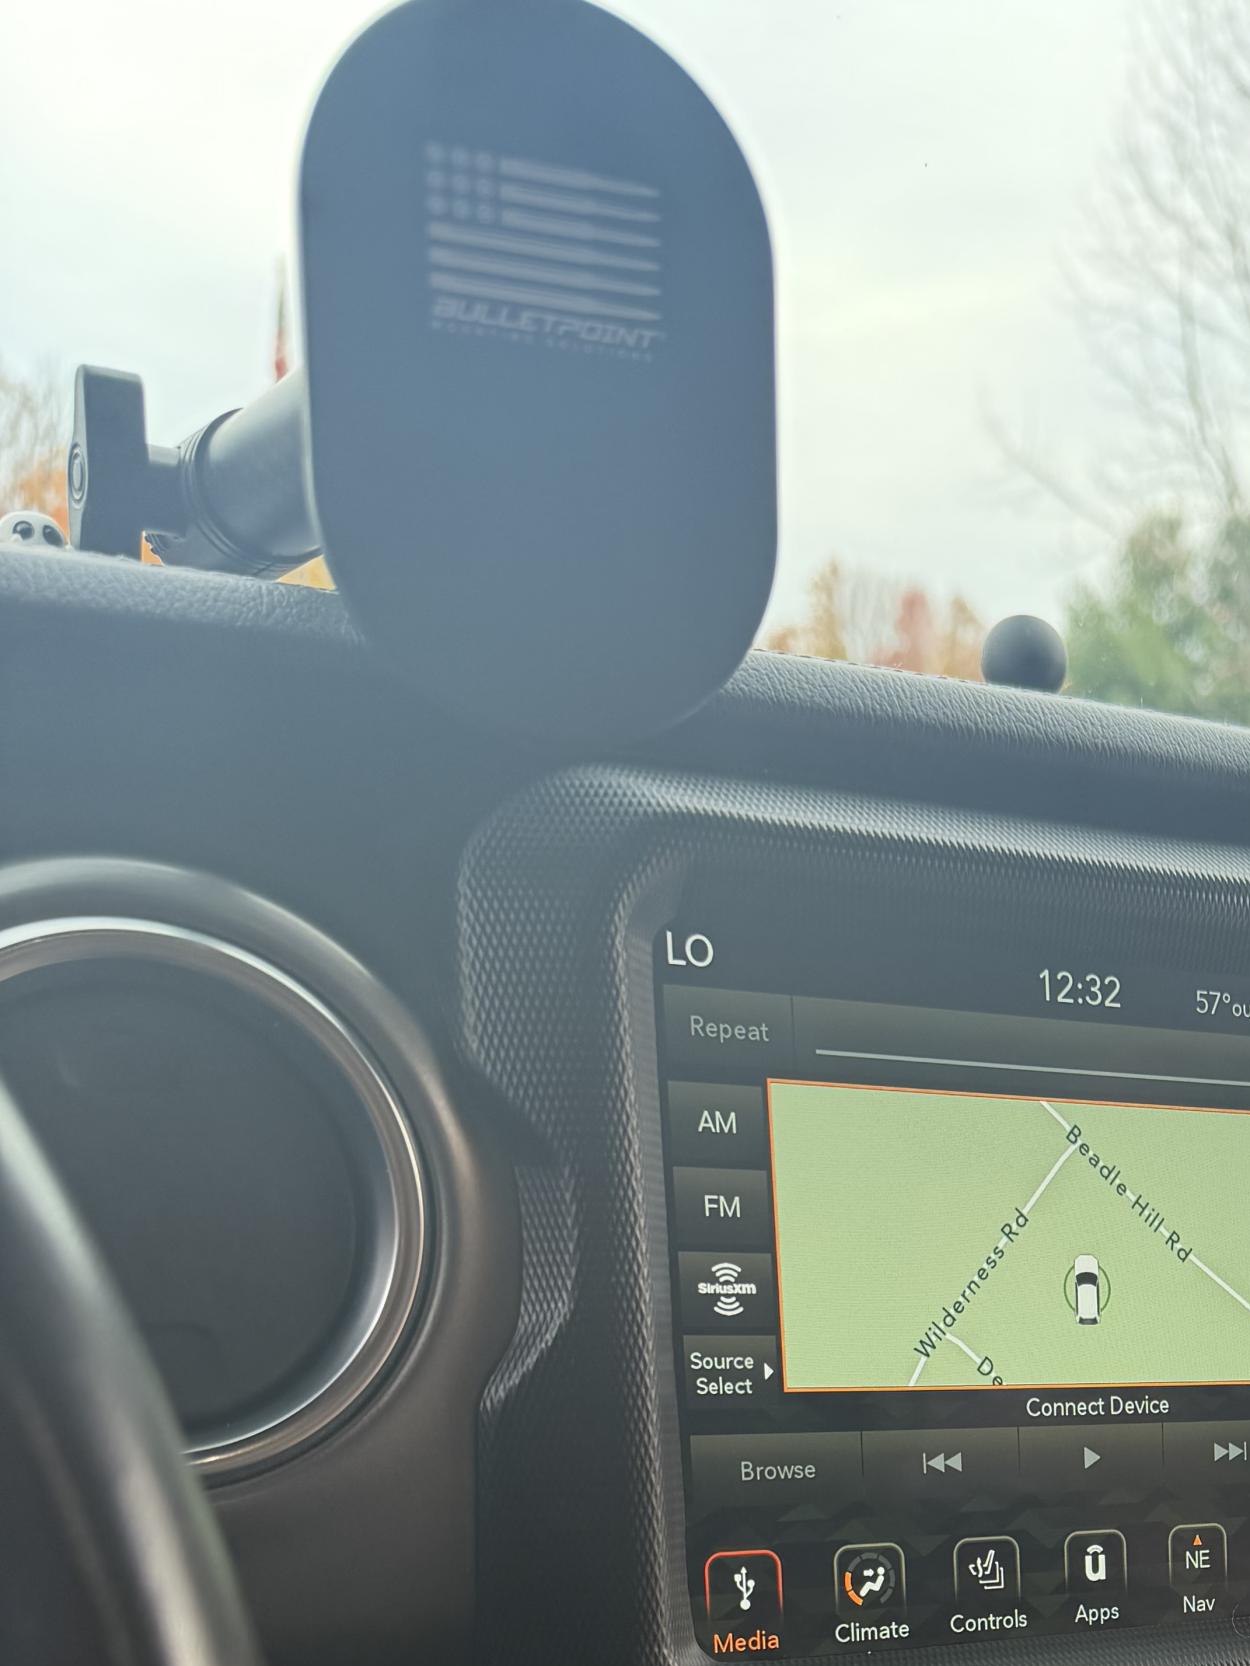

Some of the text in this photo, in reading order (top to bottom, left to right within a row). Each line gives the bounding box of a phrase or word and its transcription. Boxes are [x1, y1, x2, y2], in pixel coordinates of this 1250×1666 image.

[666, 930, 714, 968] LO
[1040, 969, 1121, 1008] 12:32
[690, 1015, 769, 1043] Repeat
[698, 1111, 737, 1134] AM
[1066, 1125, 1193, 1263] Beadle Hill Rd
[704, 1195, 741, 1218] FM
[913, 1207, 1030, 1359] Wilderness Rd
[690, 1352, 754, 1371] Source
[696, 1376, 752, 1395] Select
[1026, 1395, 1169, 1418] Connect Device
[740, 1461, 816, 1481] Browse
[1185, 1550, 1211, 1569] NE
[1075, 1604, 1120, 1624] Apps
[1183, 1596, 1216, 1613] Nav
[835, 1620, 910, 1643] Climate
[950, 1609, 1028, 1633] Controls
[713, 1630, 780, 1654] Media
